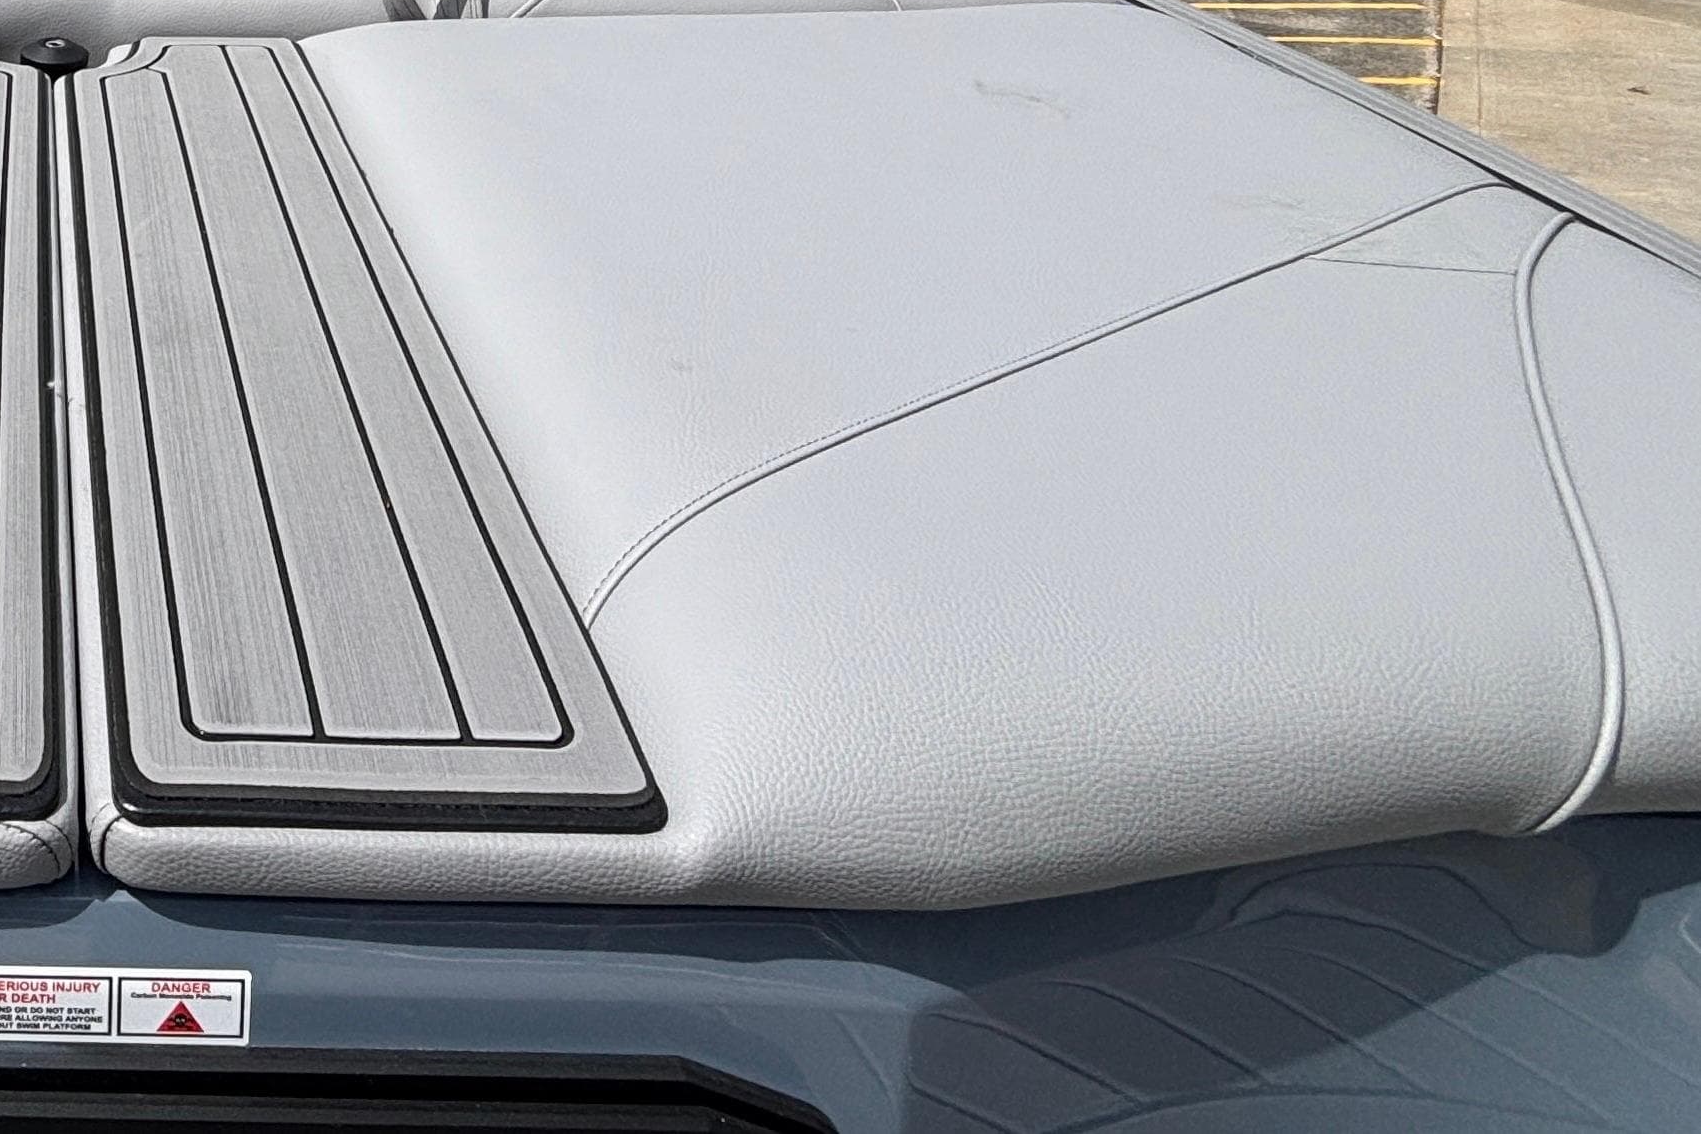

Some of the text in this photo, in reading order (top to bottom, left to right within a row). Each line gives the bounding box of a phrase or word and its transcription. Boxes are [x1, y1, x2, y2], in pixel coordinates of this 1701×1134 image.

[52, 981, 101, 993] INJURY
[151, 982, 211, 994] DANGER
[11, 993, 56, 1004] DEATH
[14, 1006, 28, 1014] OR
[67, 1007, 96, 1015] START
[14, 1014, 63, 1022] ALLOWING
[65, 1015, 103, 1023] ANYONE
[42, 1023, 92, 1031] PLATFORM
